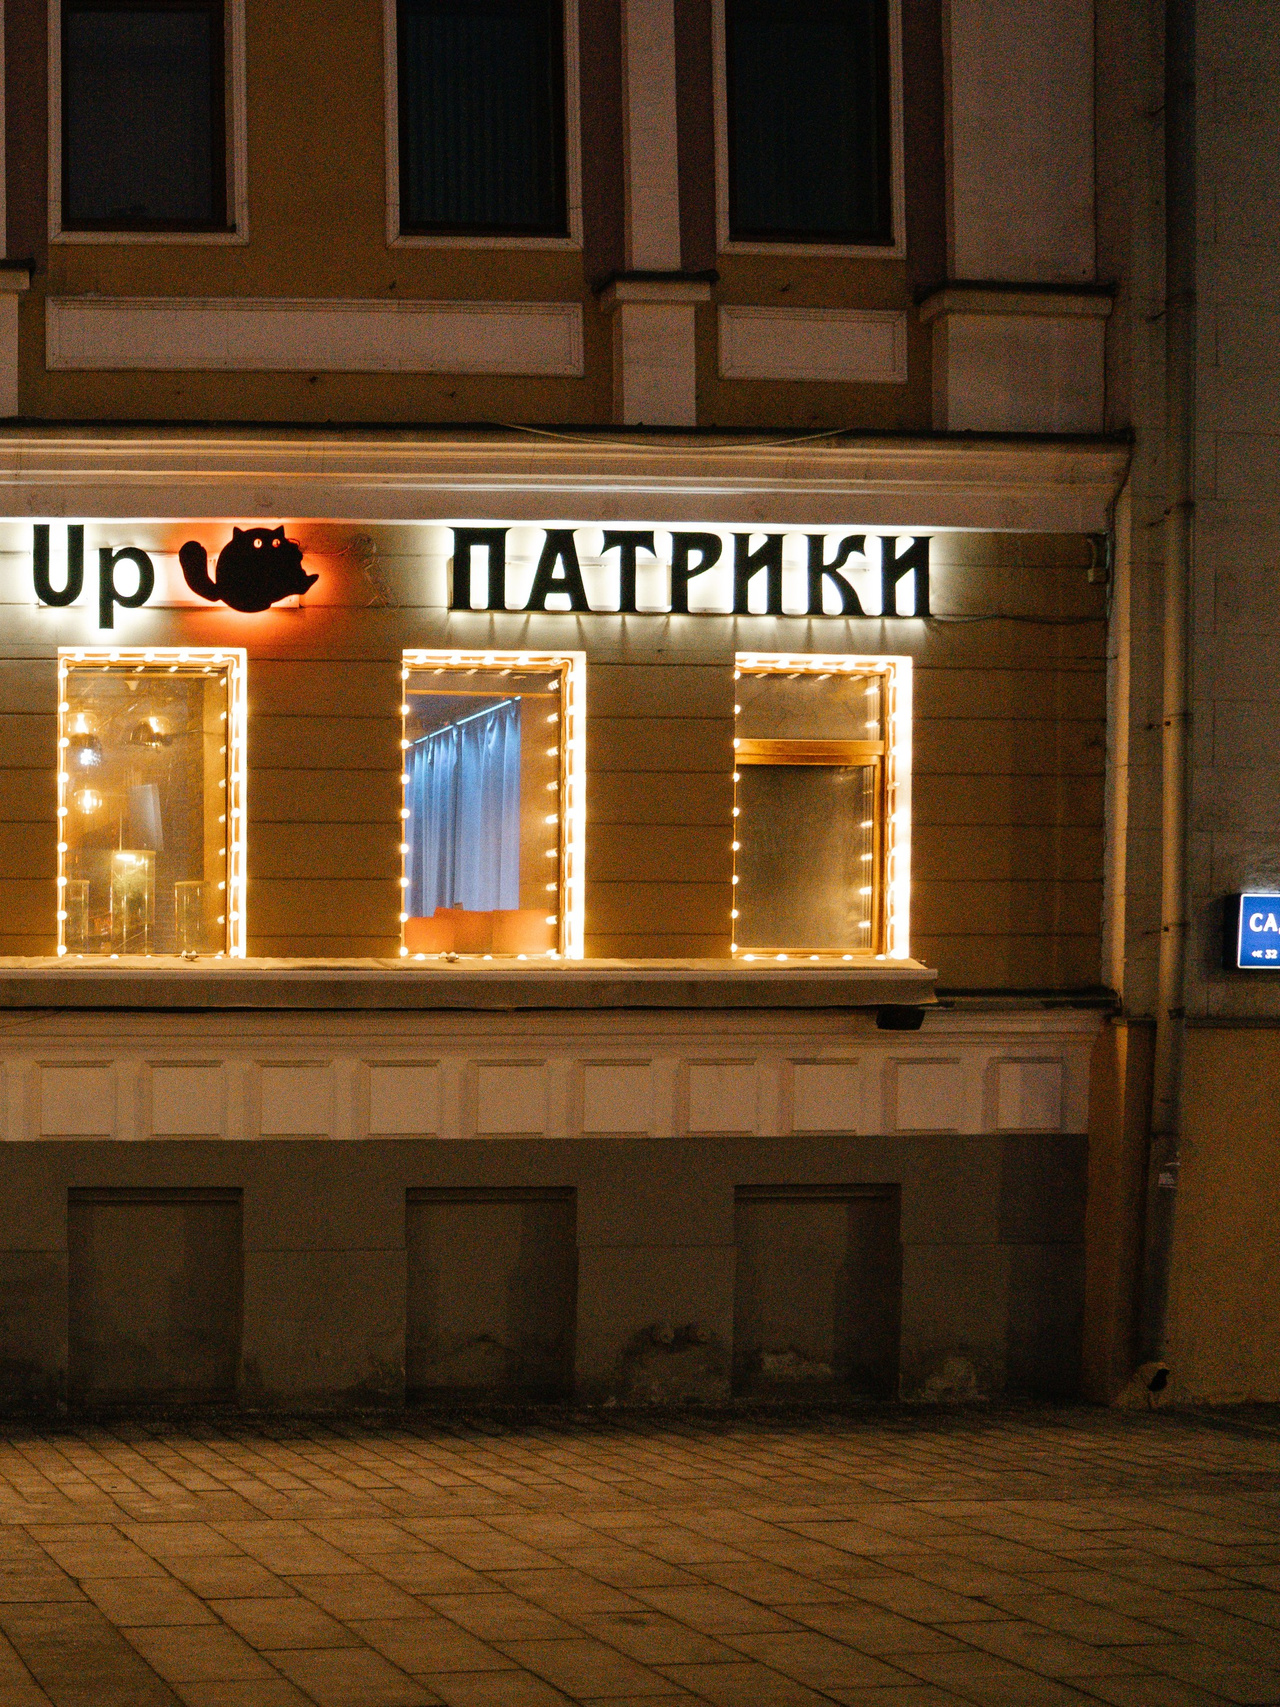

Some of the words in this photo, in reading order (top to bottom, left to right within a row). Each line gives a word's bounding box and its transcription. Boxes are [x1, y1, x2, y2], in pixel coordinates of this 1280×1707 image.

[33, 524, 155, 629] Up
[449, 527, 934, 617] ПАТРИКИ
[1249, 912, 1280, 935] СА
